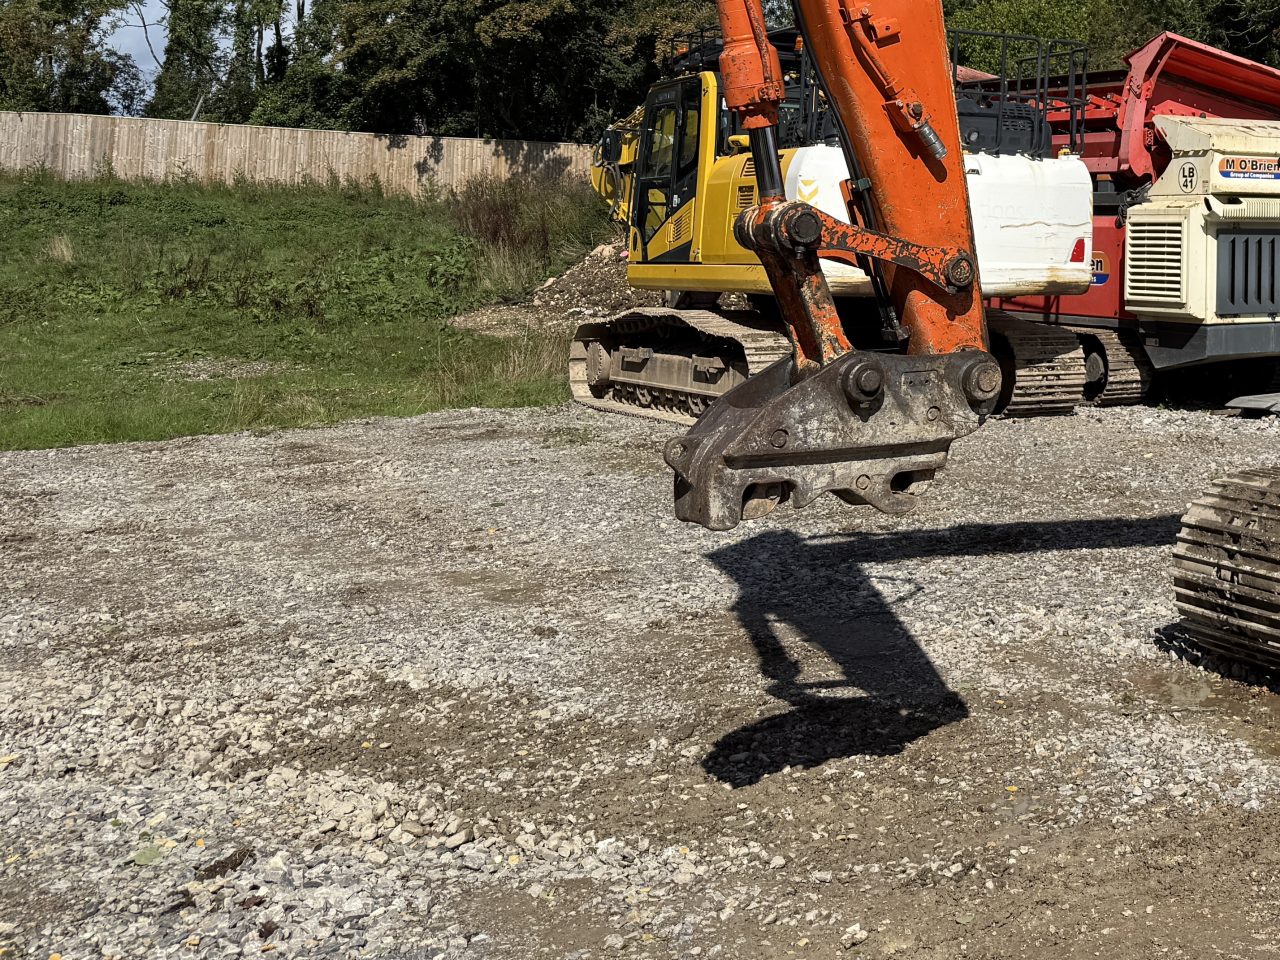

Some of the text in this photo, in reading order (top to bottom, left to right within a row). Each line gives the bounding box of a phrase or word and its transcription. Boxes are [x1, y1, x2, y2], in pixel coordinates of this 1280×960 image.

[1226, 159, 1280, 171] M O'Brien
[1182, 167, 1195, 178] LB
[1182, 178, 1194, 189] 41
